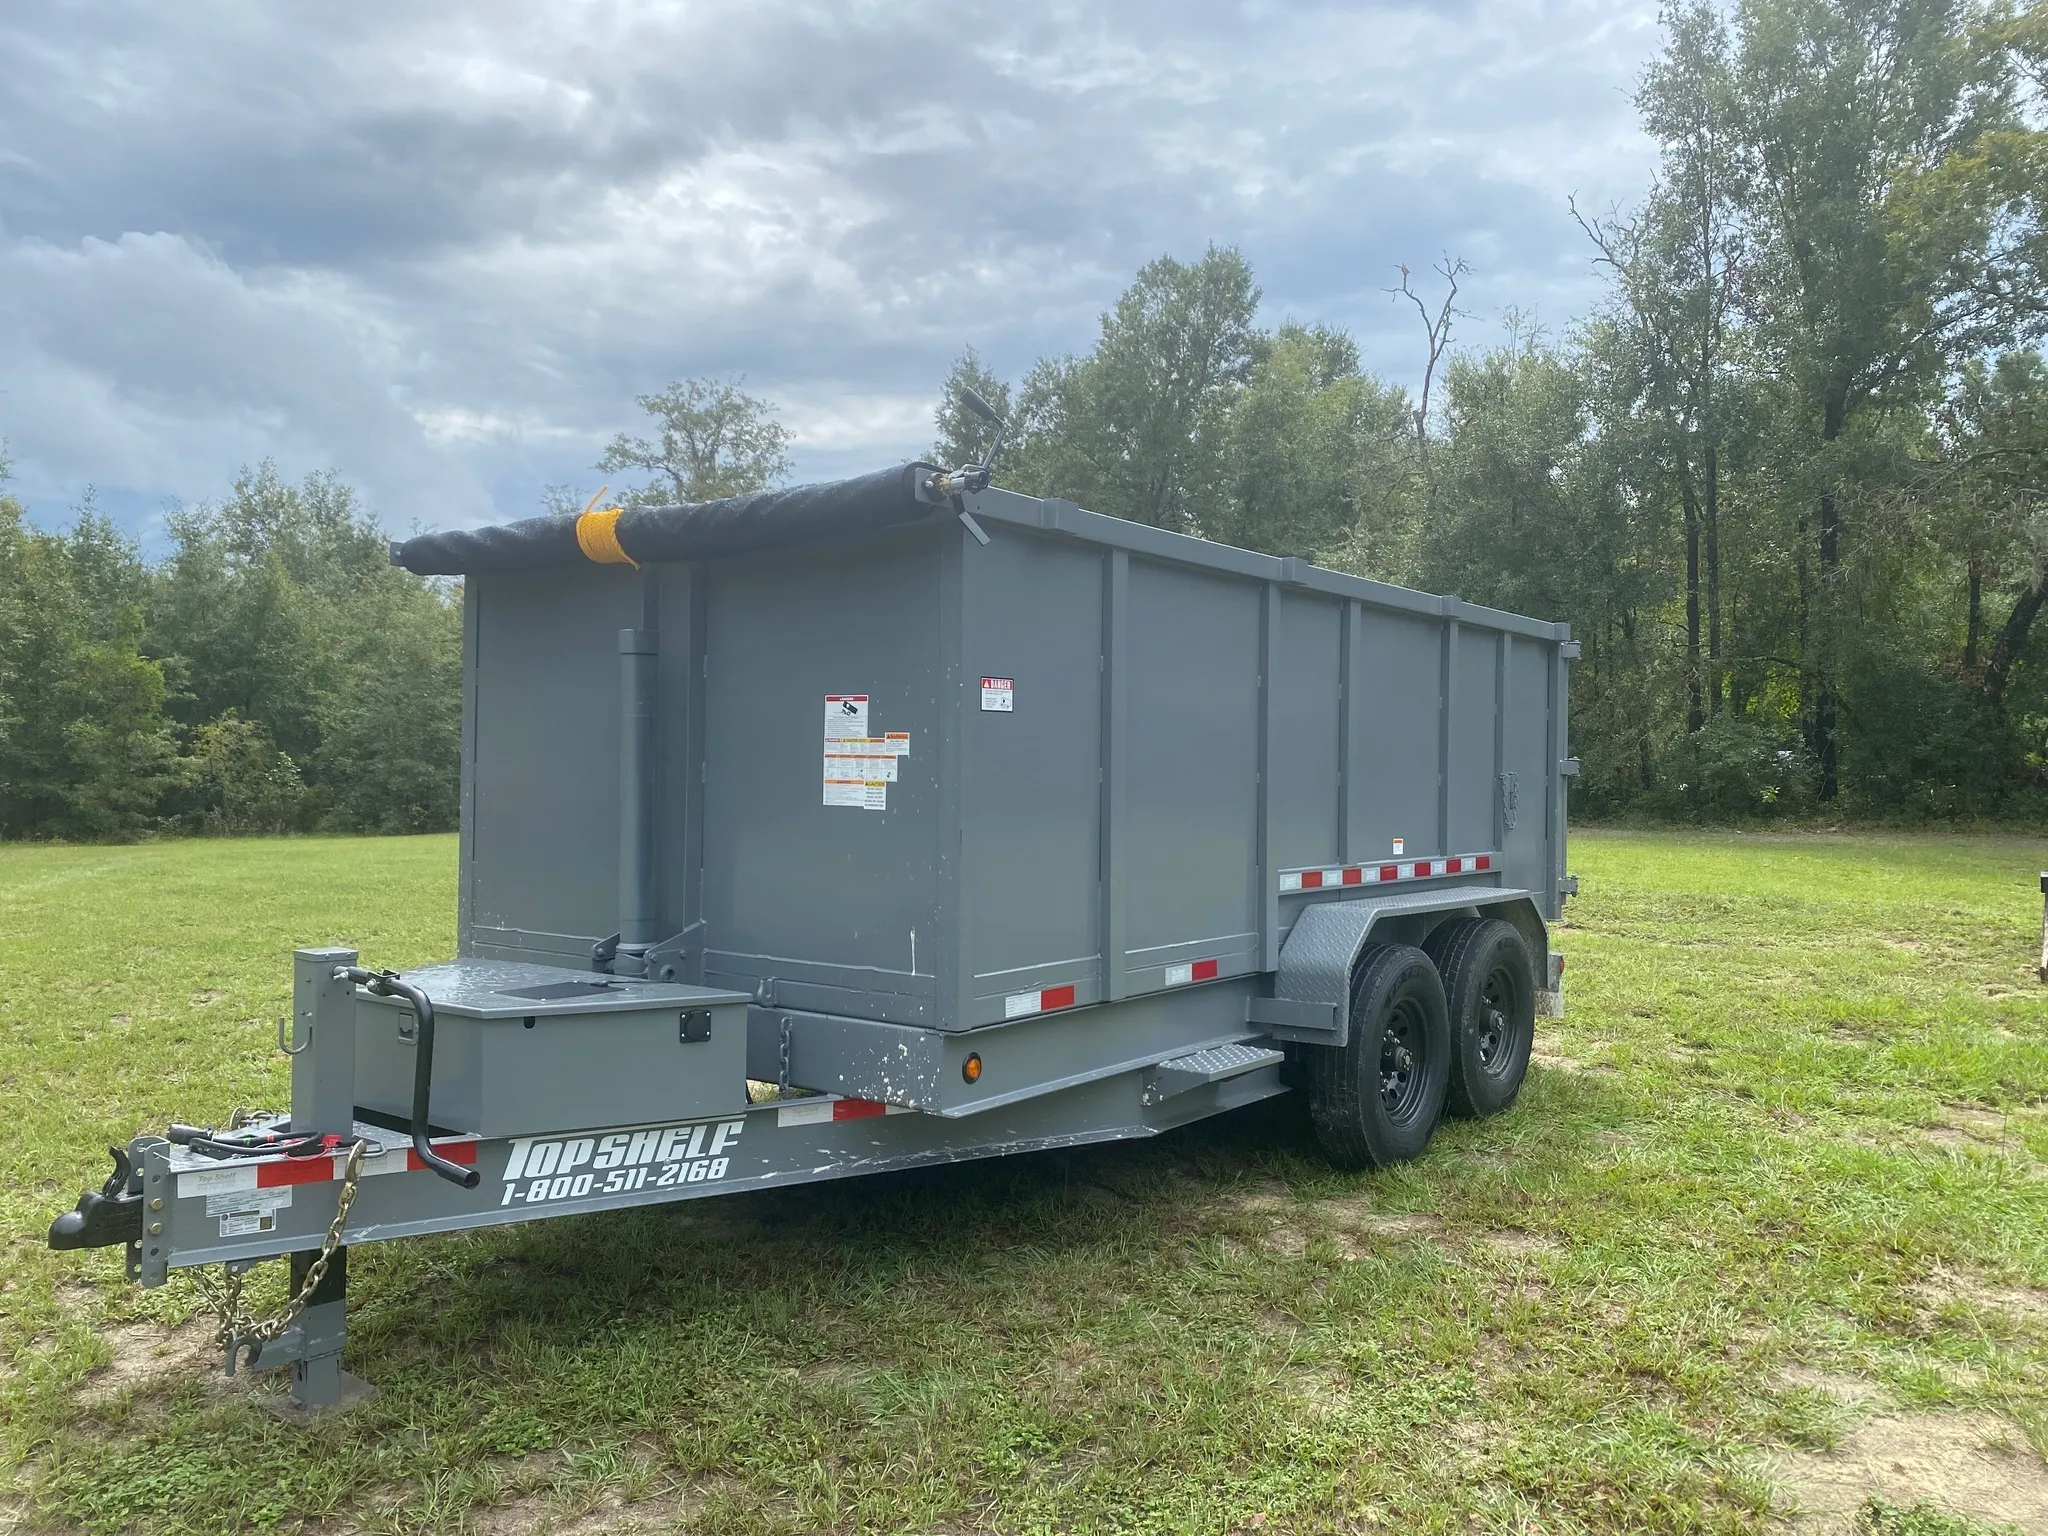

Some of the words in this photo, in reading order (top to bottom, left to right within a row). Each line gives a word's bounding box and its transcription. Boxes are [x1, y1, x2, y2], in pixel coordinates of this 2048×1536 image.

[990, 679, 1011, 689] DANGER
[198, 1175, 213, 1183] Top
[214, 1172, 237, 1181] Shelf
[501, 1157, 730, 1206] 1-800-511-2168
